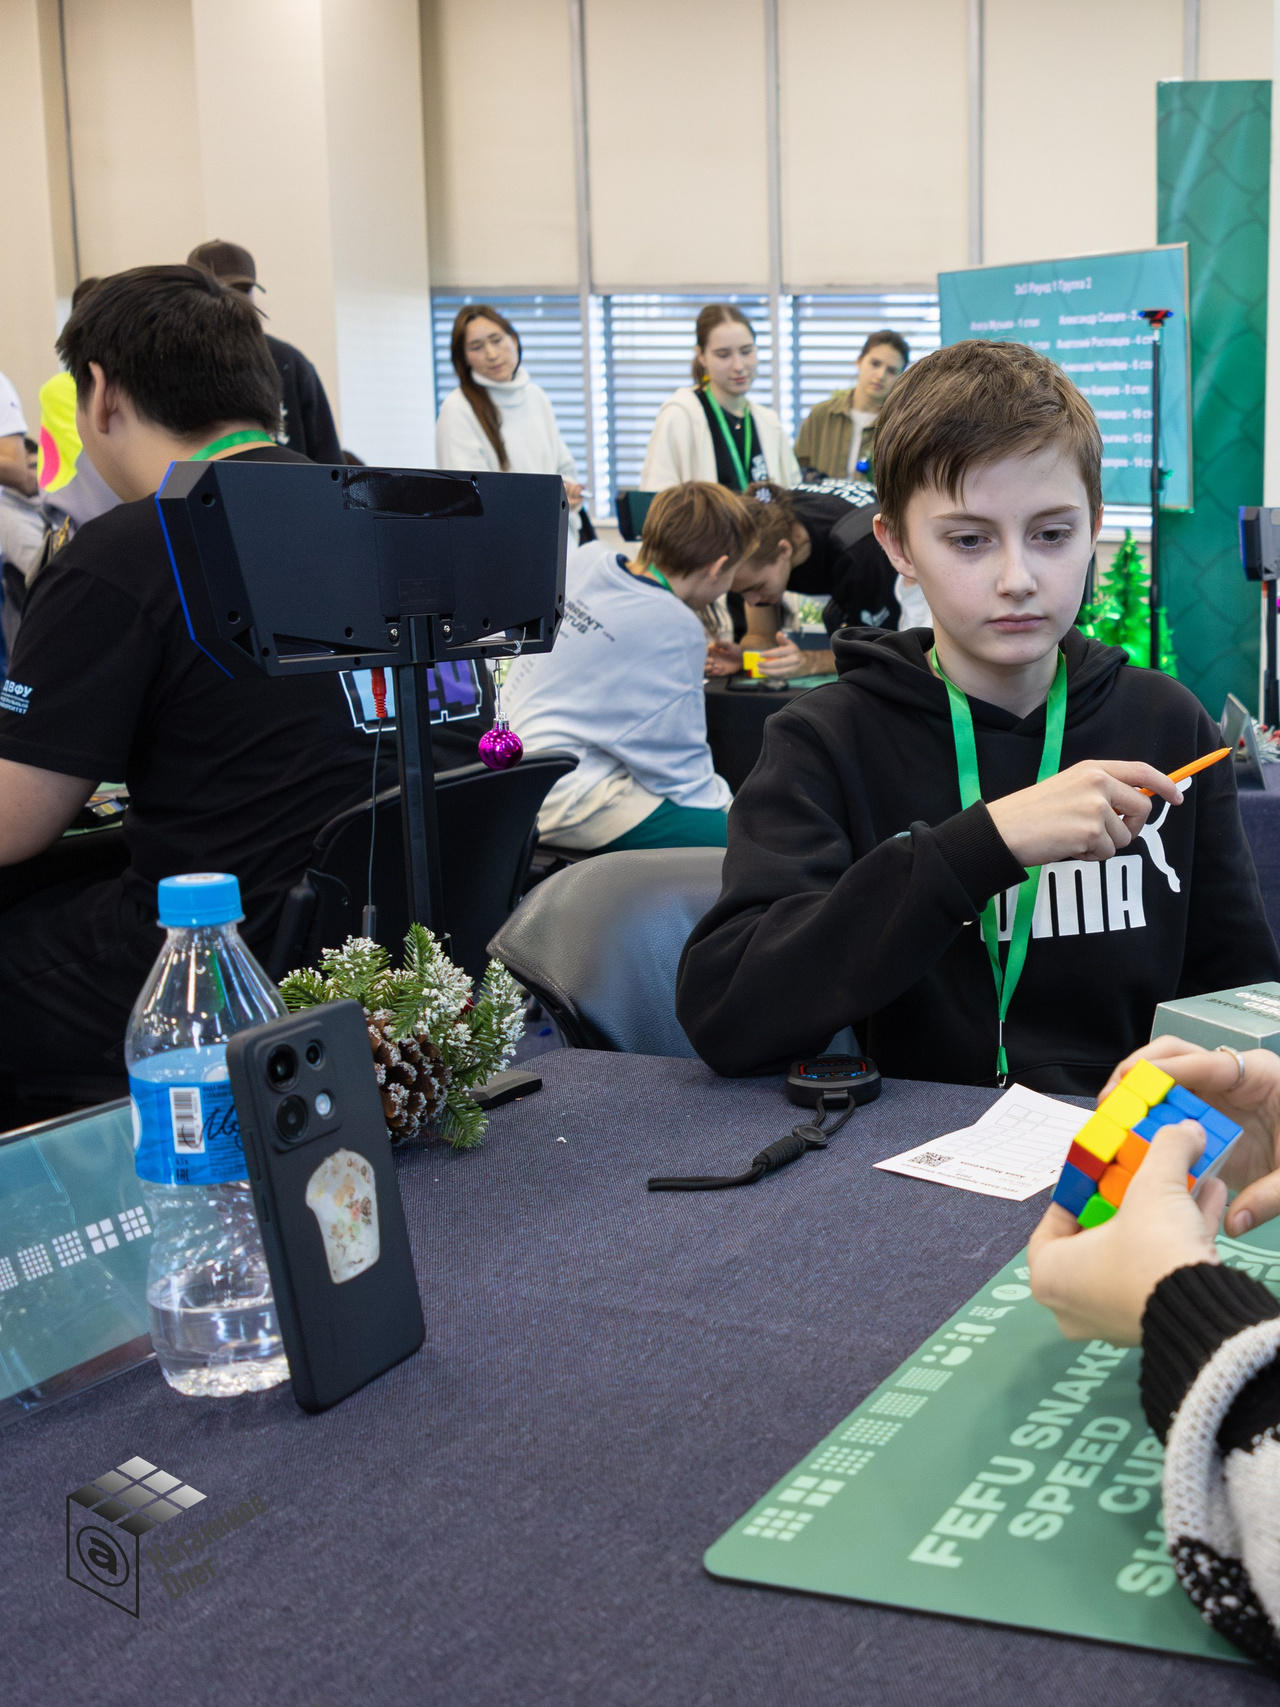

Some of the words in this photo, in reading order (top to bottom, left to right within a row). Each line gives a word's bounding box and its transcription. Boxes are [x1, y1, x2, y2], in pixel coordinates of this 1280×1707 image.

[962, 854, 1147, 942] UMA
[908, 1455, 1036, 1569] FEFU
[1009, 1339, 1130, 1450] SNAKE
[1007, 1416, 1132, 1541] SPEED
